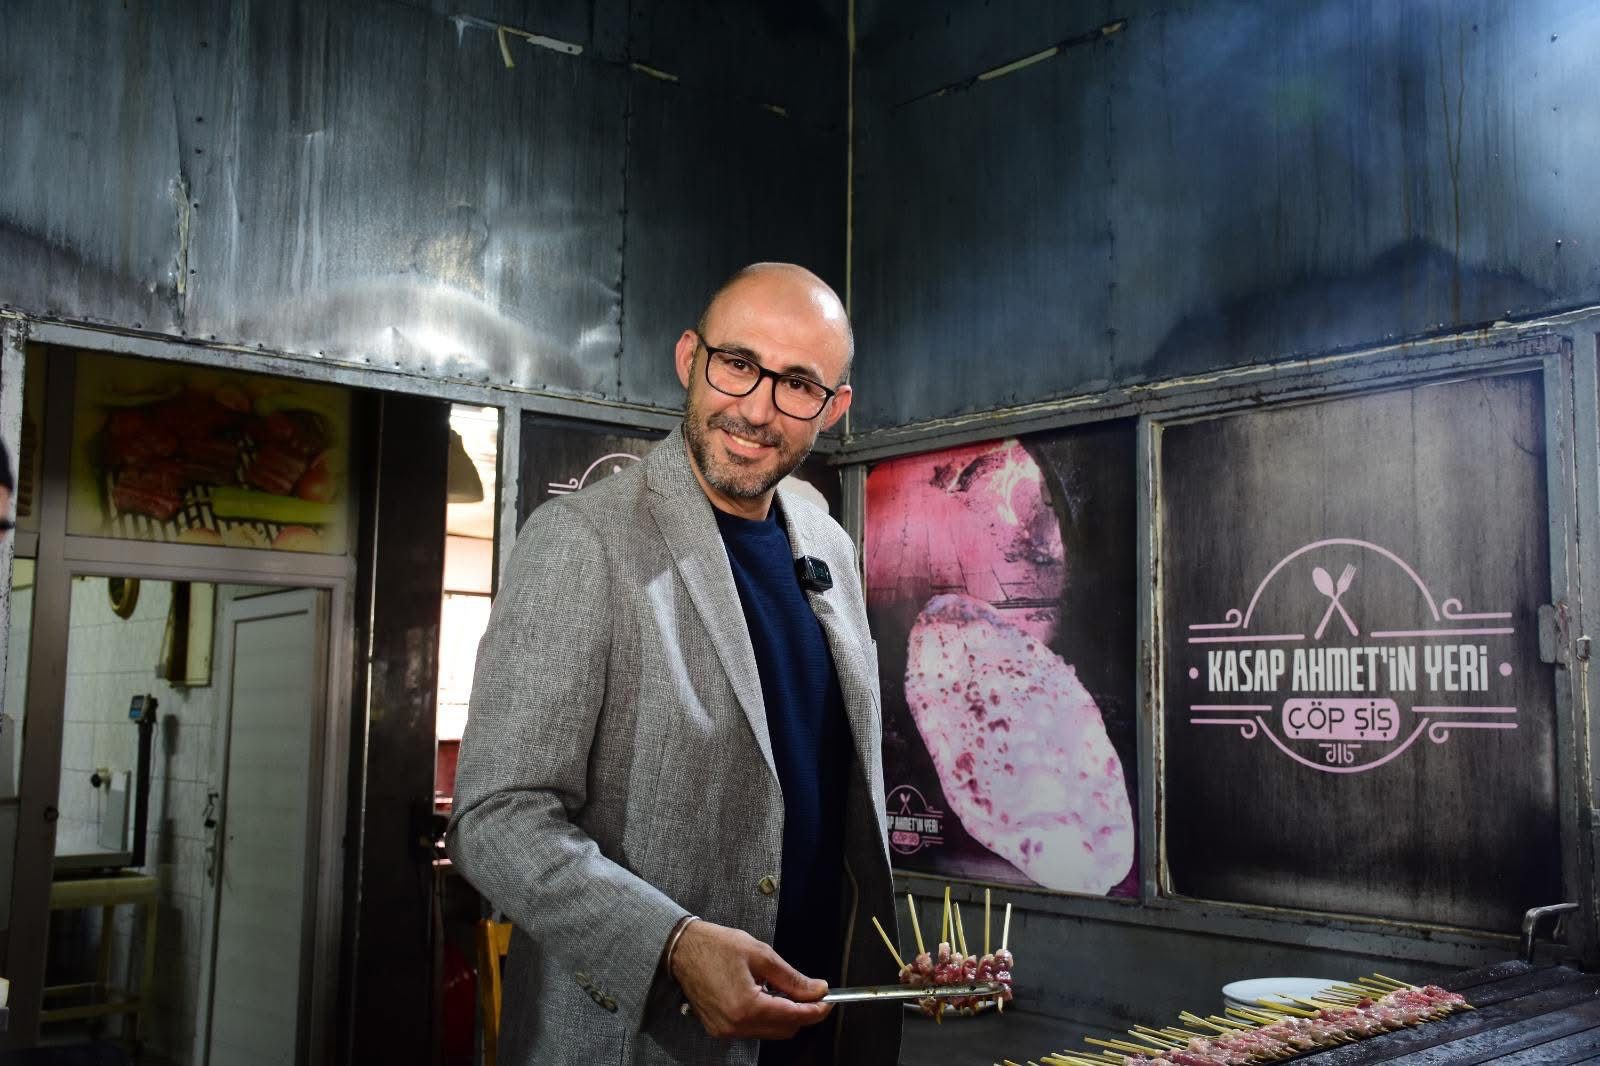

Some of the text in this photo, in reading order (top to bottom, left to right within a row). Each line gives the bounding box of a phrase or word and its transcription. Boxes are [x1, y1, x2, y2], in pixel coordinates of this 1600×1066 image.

[1208, 650, 1285, 691] KASAP
[1289, 702, 1392, 736] ÇÖP ŞİŞ
